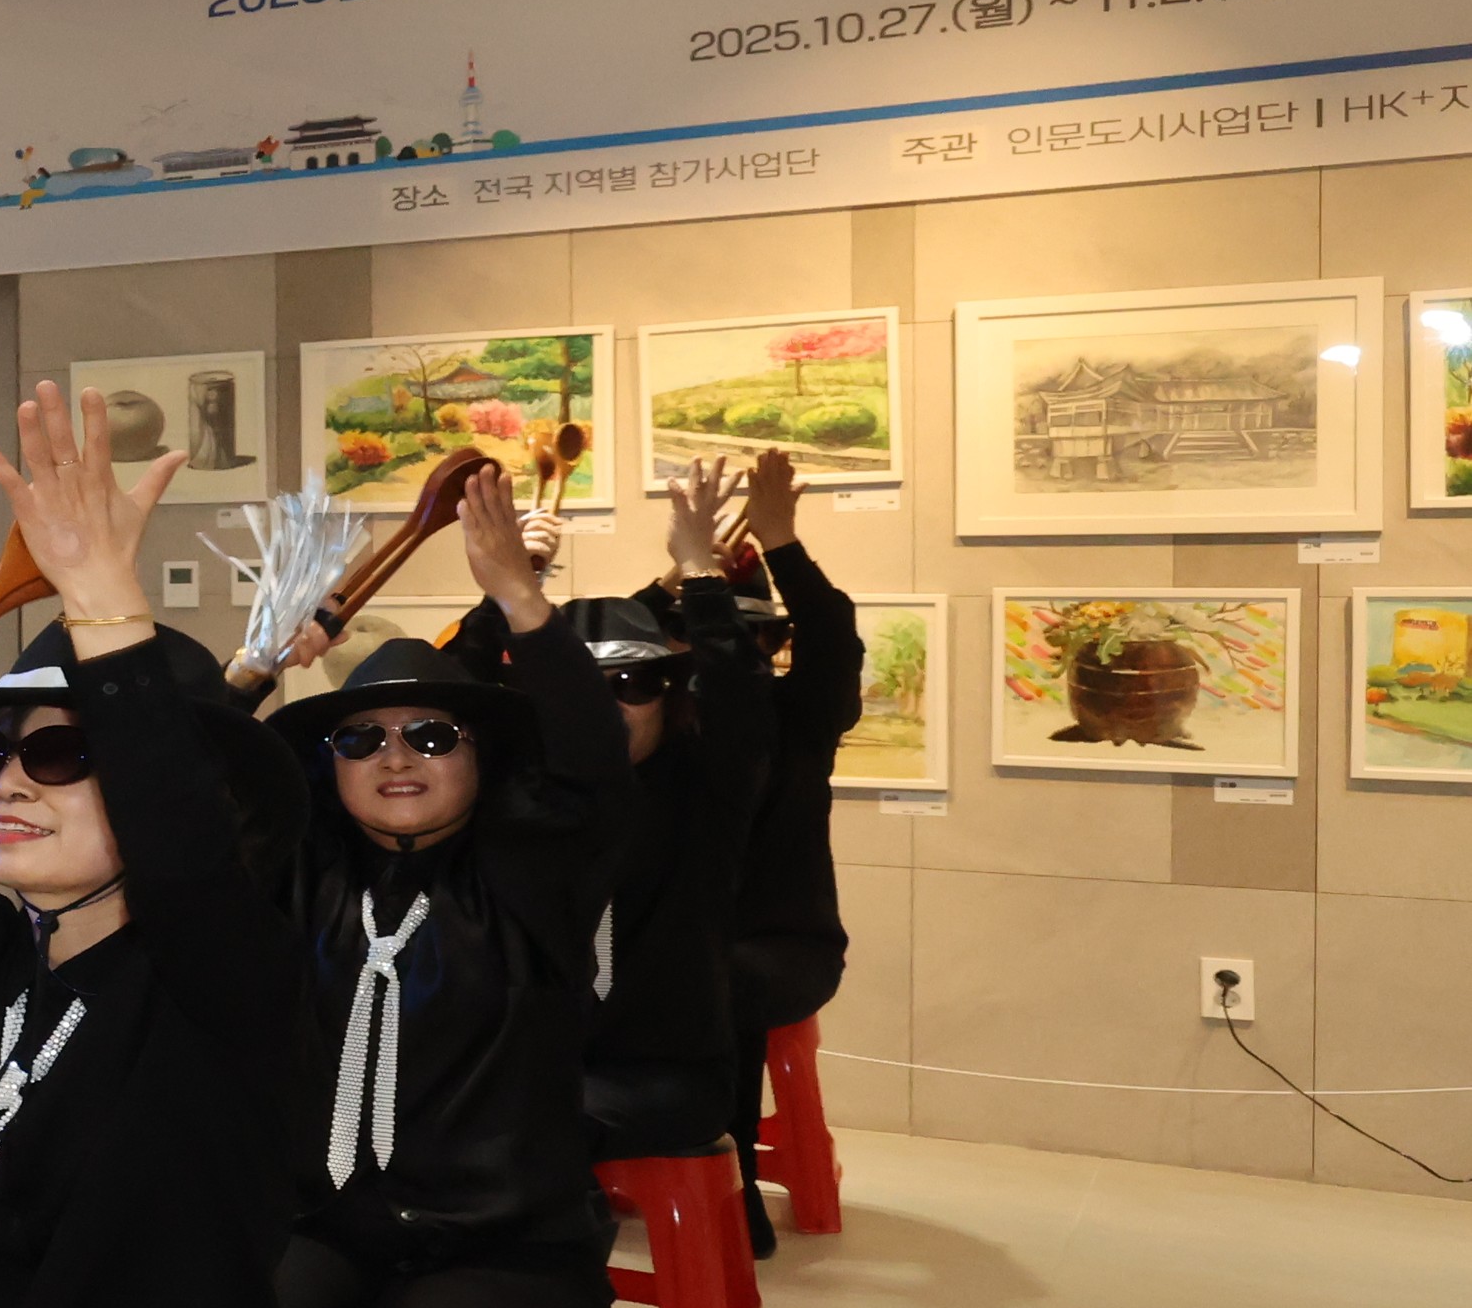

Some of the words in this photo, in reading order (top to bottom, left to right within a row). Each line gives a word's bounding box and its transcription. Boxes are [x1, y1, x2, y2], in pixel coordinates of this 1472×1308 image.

[901, 132, 977, 165] 주관
[1007, 100, 1299, 156] 인문도시사업단
[392, 180, 449, 213] 장소
[473, 175, 533, 205] 전국
[544, 165, 637, 197] 지역별
[649, 148, 821, 188] 참가사업단
